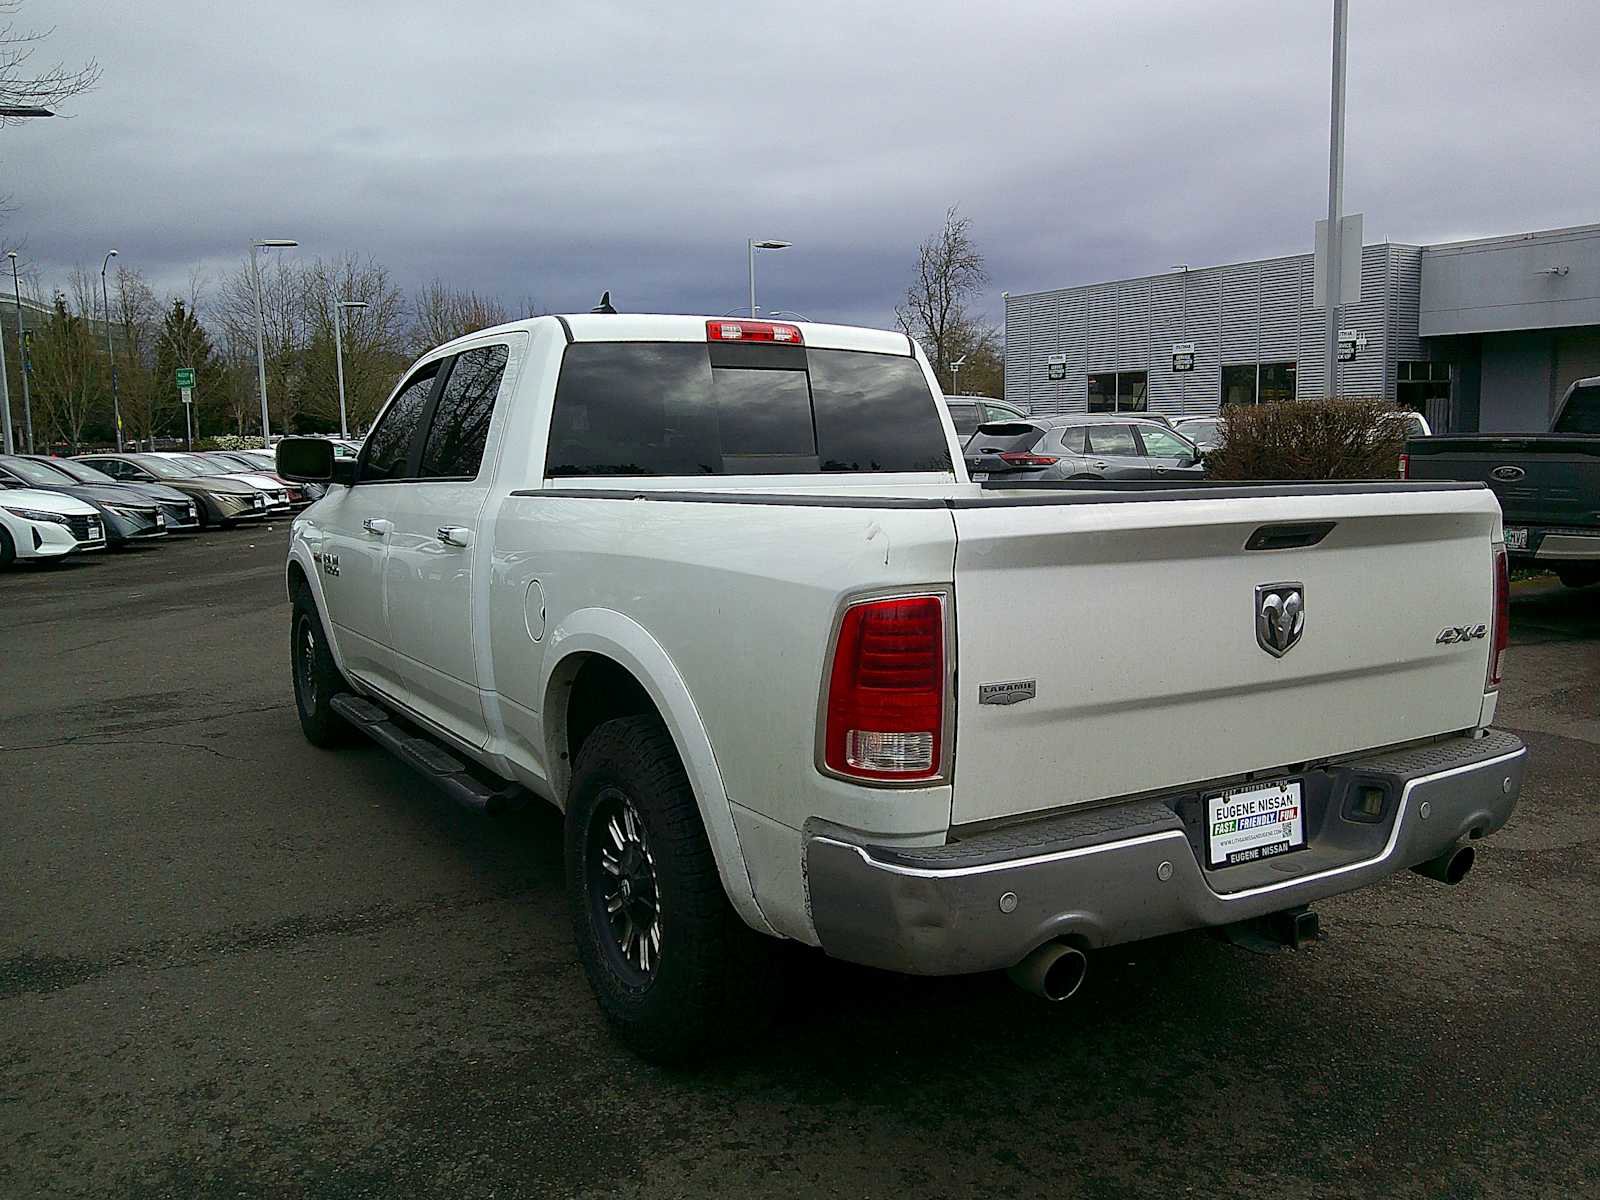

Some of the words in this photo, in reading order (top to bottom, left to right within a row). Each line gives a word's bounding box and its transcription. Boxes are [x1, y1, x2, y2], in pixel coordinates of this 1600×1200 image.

[983, 682, 1034, 693] LARAMIE
[1216, 801, 1255, 820] EUGENE
[1258, 794, 1293, 812] NISSAN
[1214, 821, 1235, 836] FAST.
[1239, 812, 1276, 830] FRIENDLY.
[1230, 848, 1260, 863] EUGENE
[1261, 842, 1289, 857] NISSAN
